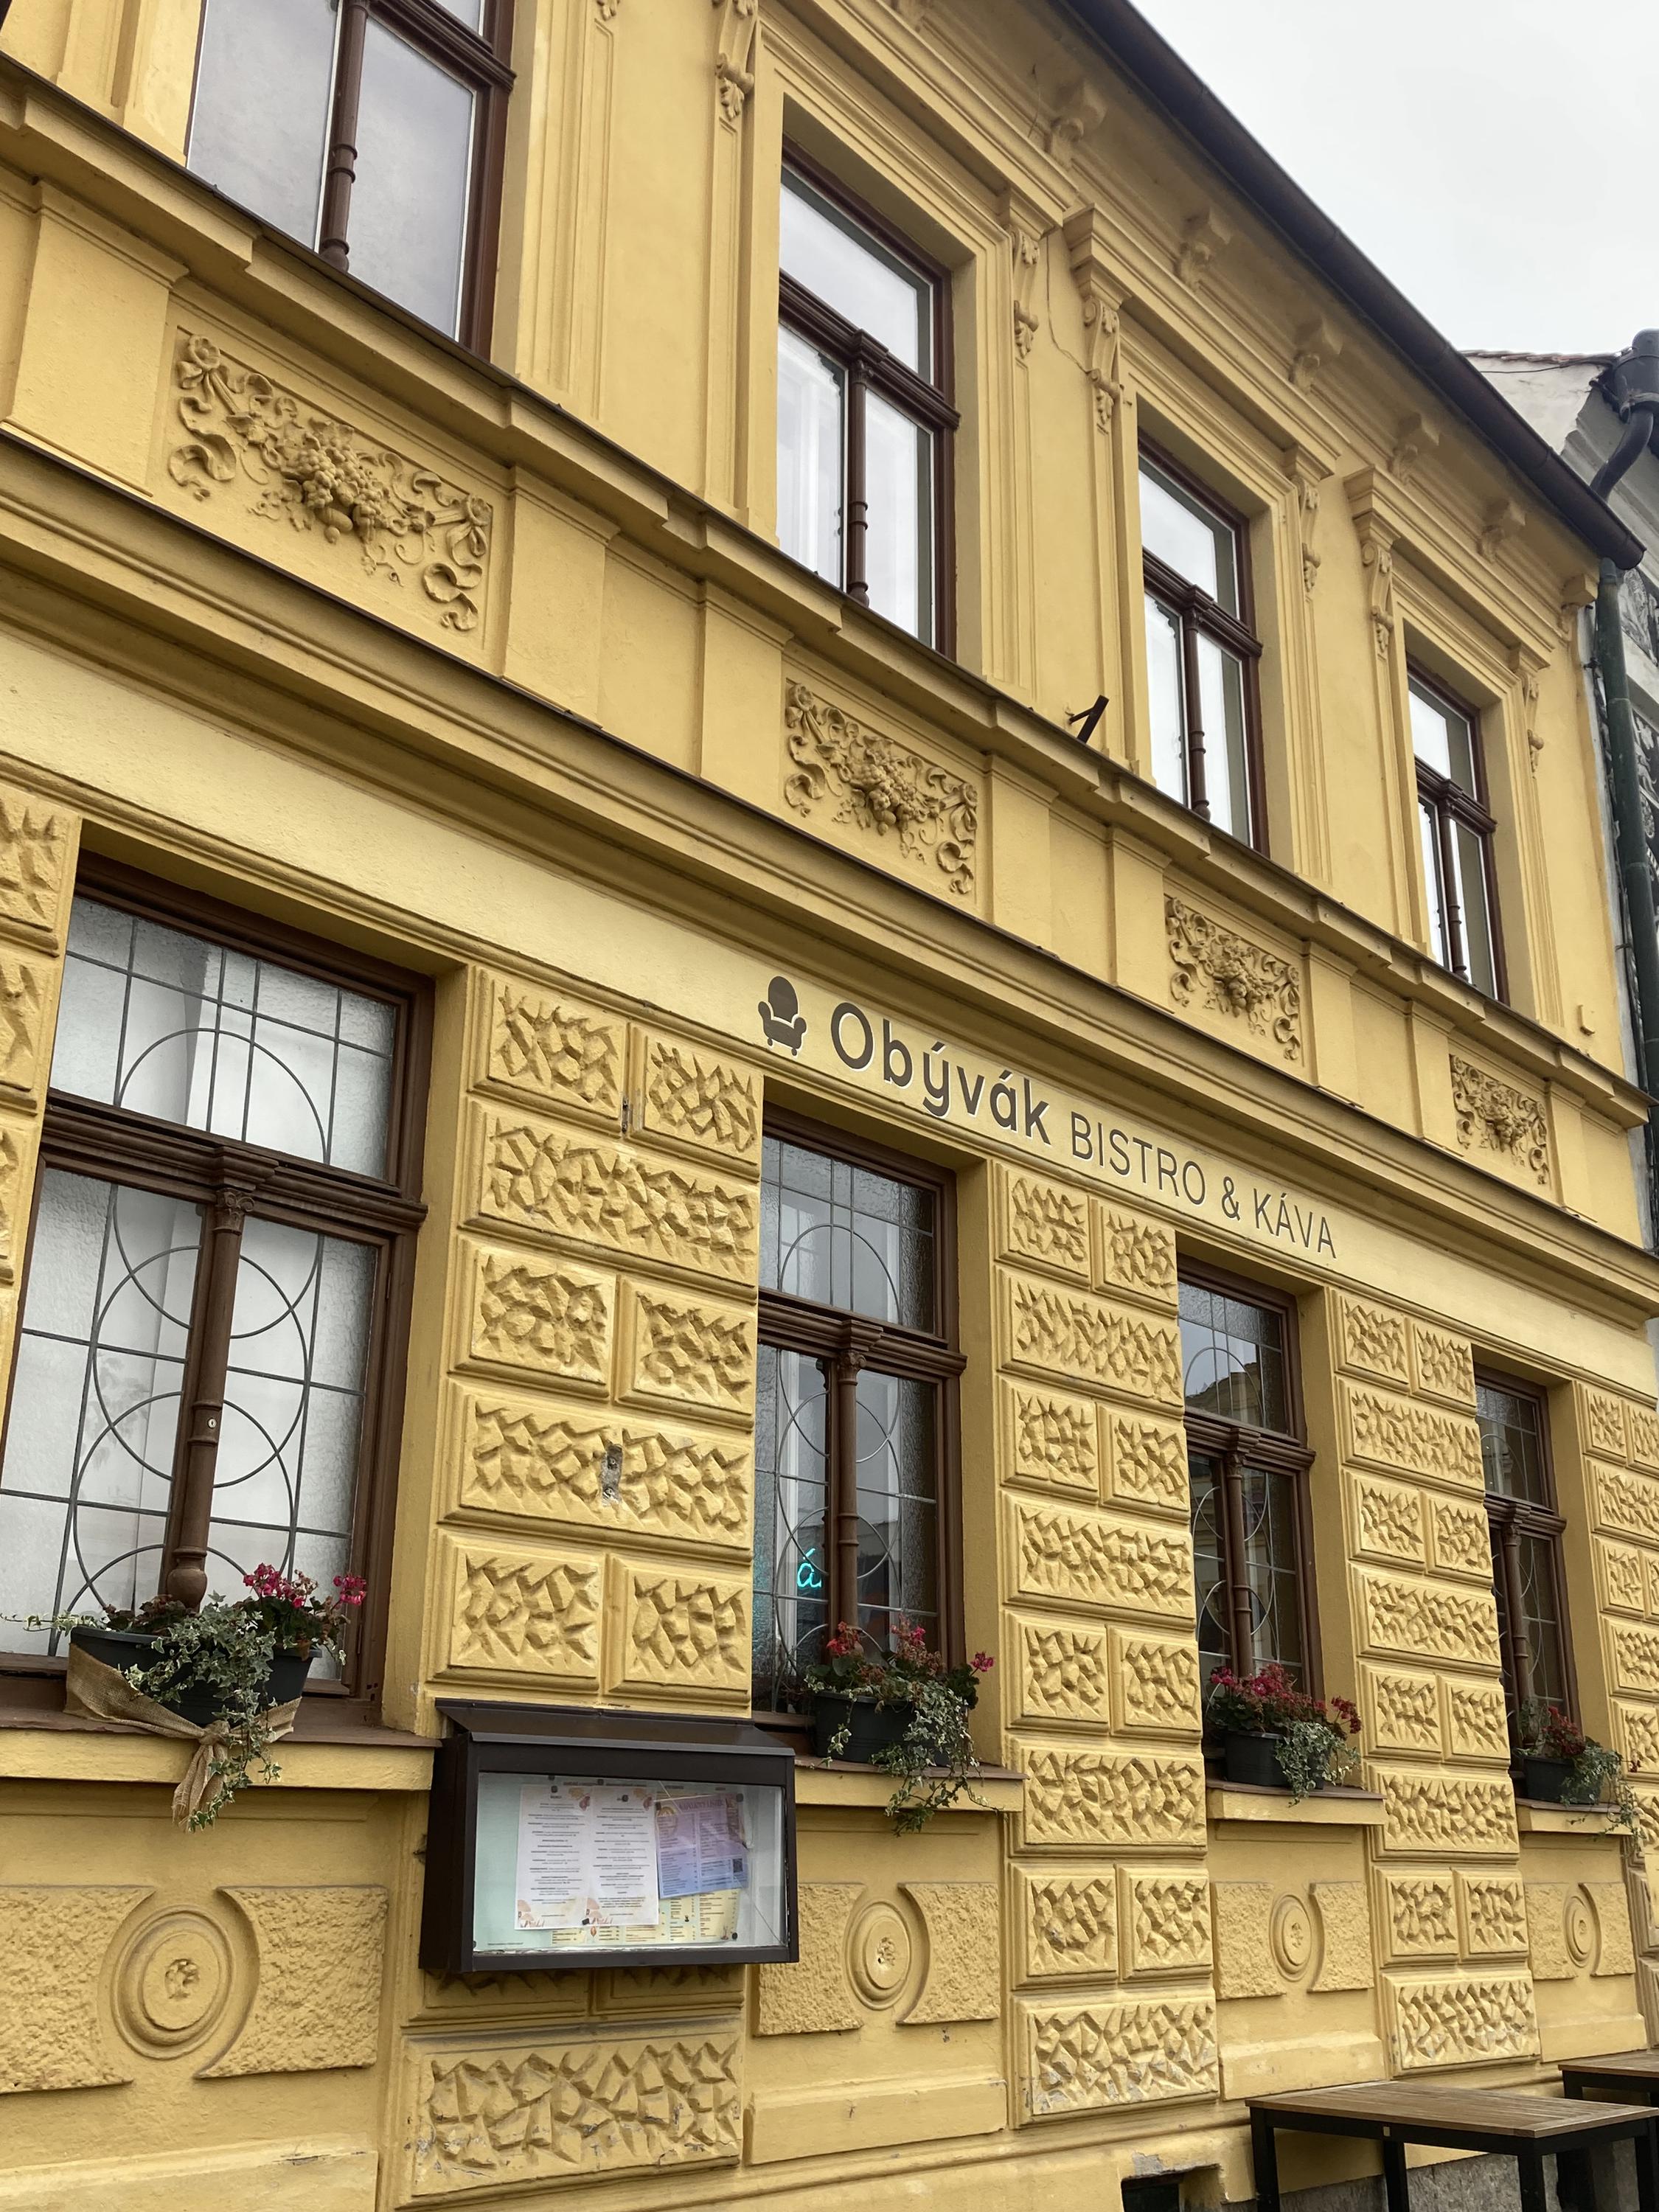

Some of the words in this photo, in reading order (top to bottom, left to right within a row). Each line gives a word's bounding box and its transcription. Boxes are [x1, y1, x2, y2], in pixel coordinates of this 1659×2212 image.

[830, 1002, 1051, 1145] Obývák
[1071, 1111, 1206, 1205] BISTRO
[1221, 1176, 1241, 1220] &
[1253, 1188, 1337, 1259] KÁVA
